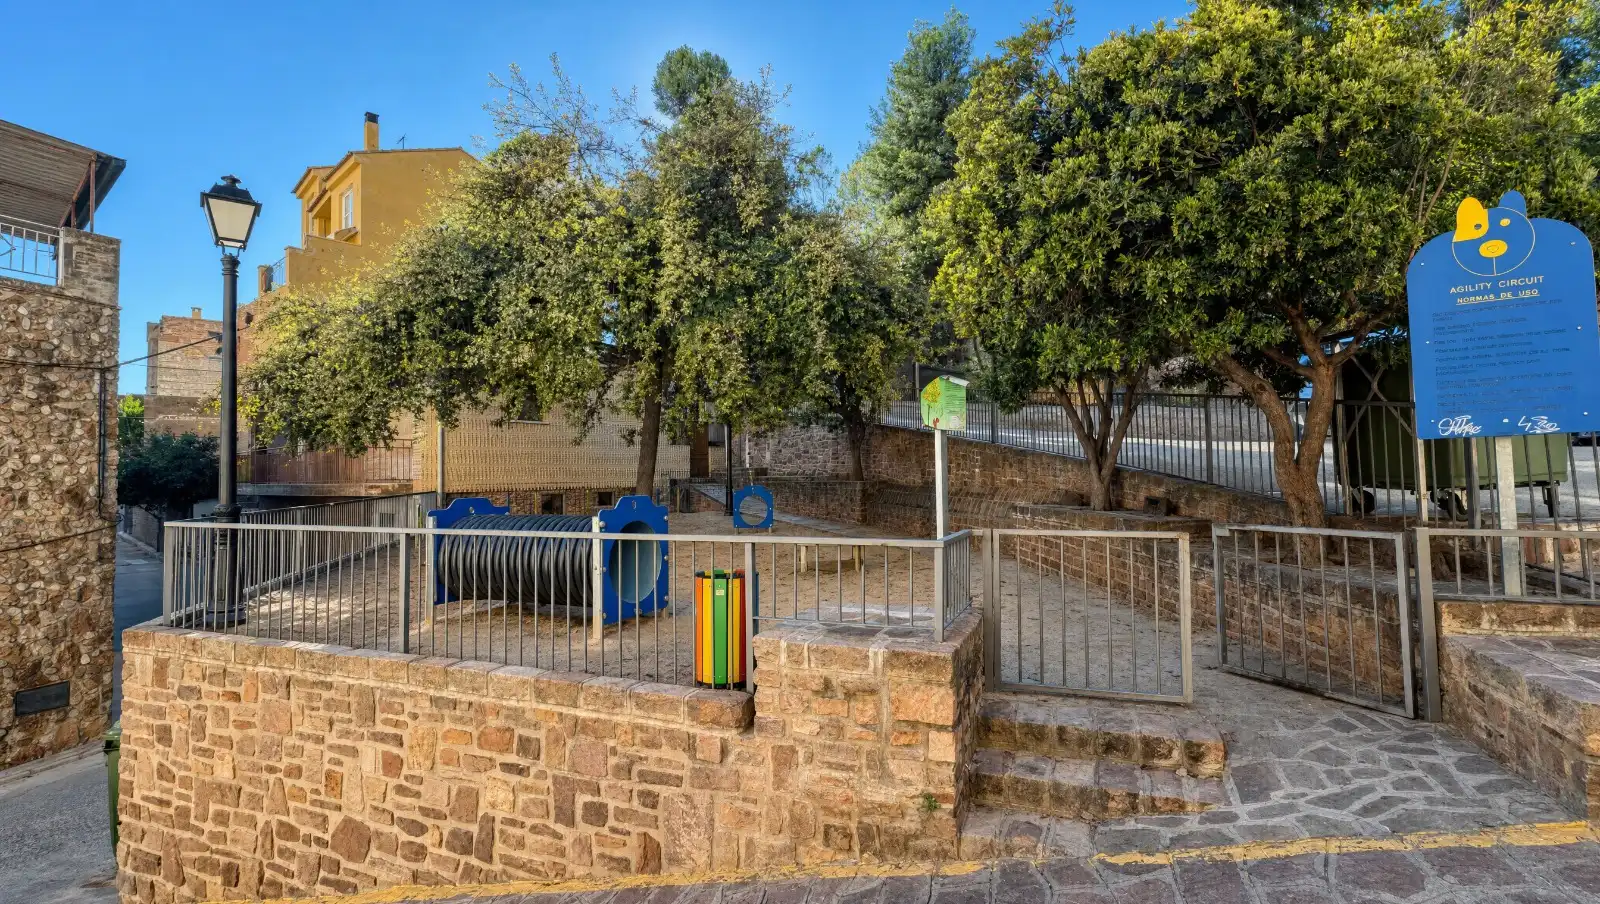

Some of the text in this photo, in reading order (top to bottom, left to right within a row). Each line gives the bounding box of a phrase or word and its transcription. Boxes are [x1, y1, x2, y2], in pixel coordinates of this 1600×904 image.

[1450, 276, 1544, 294] AGILITY CIRCUIT
[1457, 294, 1495, 303] NORMAS
